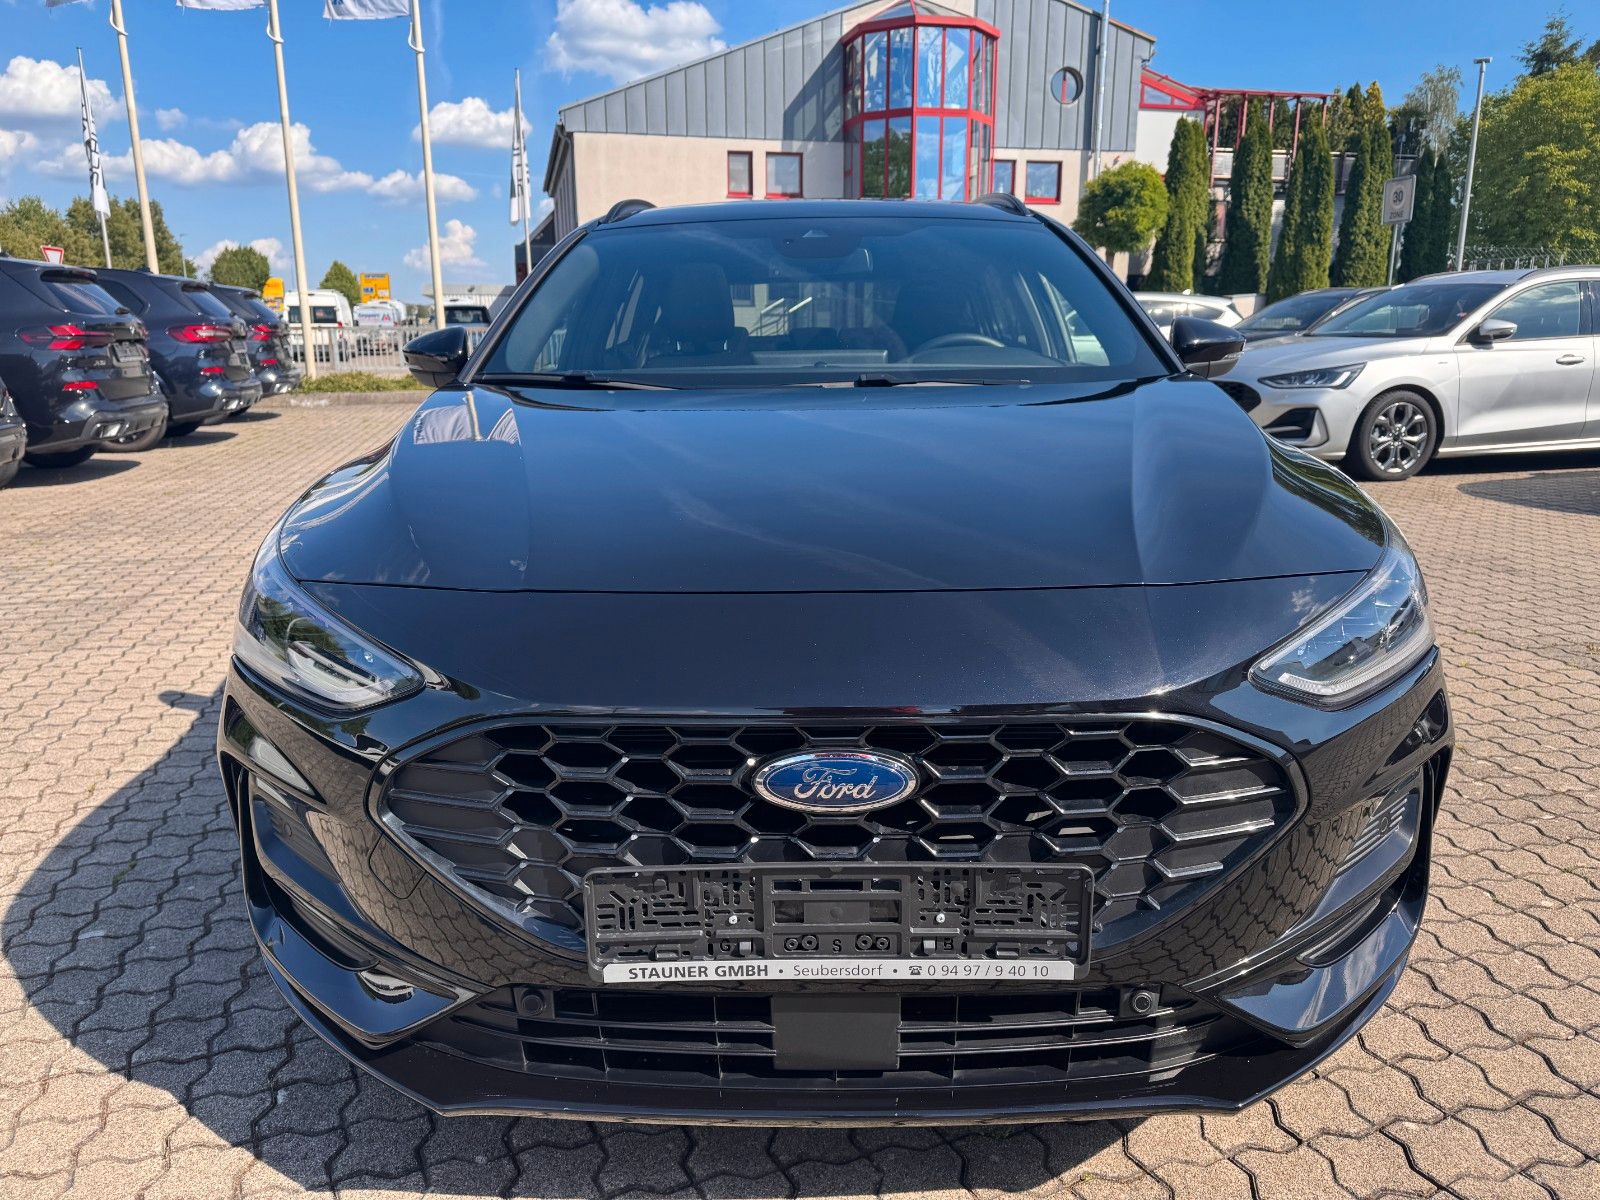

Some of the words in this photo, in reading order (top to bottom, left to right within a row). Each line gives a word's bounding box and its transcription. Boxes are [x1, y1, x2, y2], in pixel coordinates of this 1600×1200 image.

[1393, 190, 1404, 204] 30
[794, 766, 878, 799] Ford
[832, 938, 843, 953] S
[628, 965, 709, 980] STAUNER
[714, 964, 768, 978] GMBH
[793, 963, 883, 977] Seubersdorf
